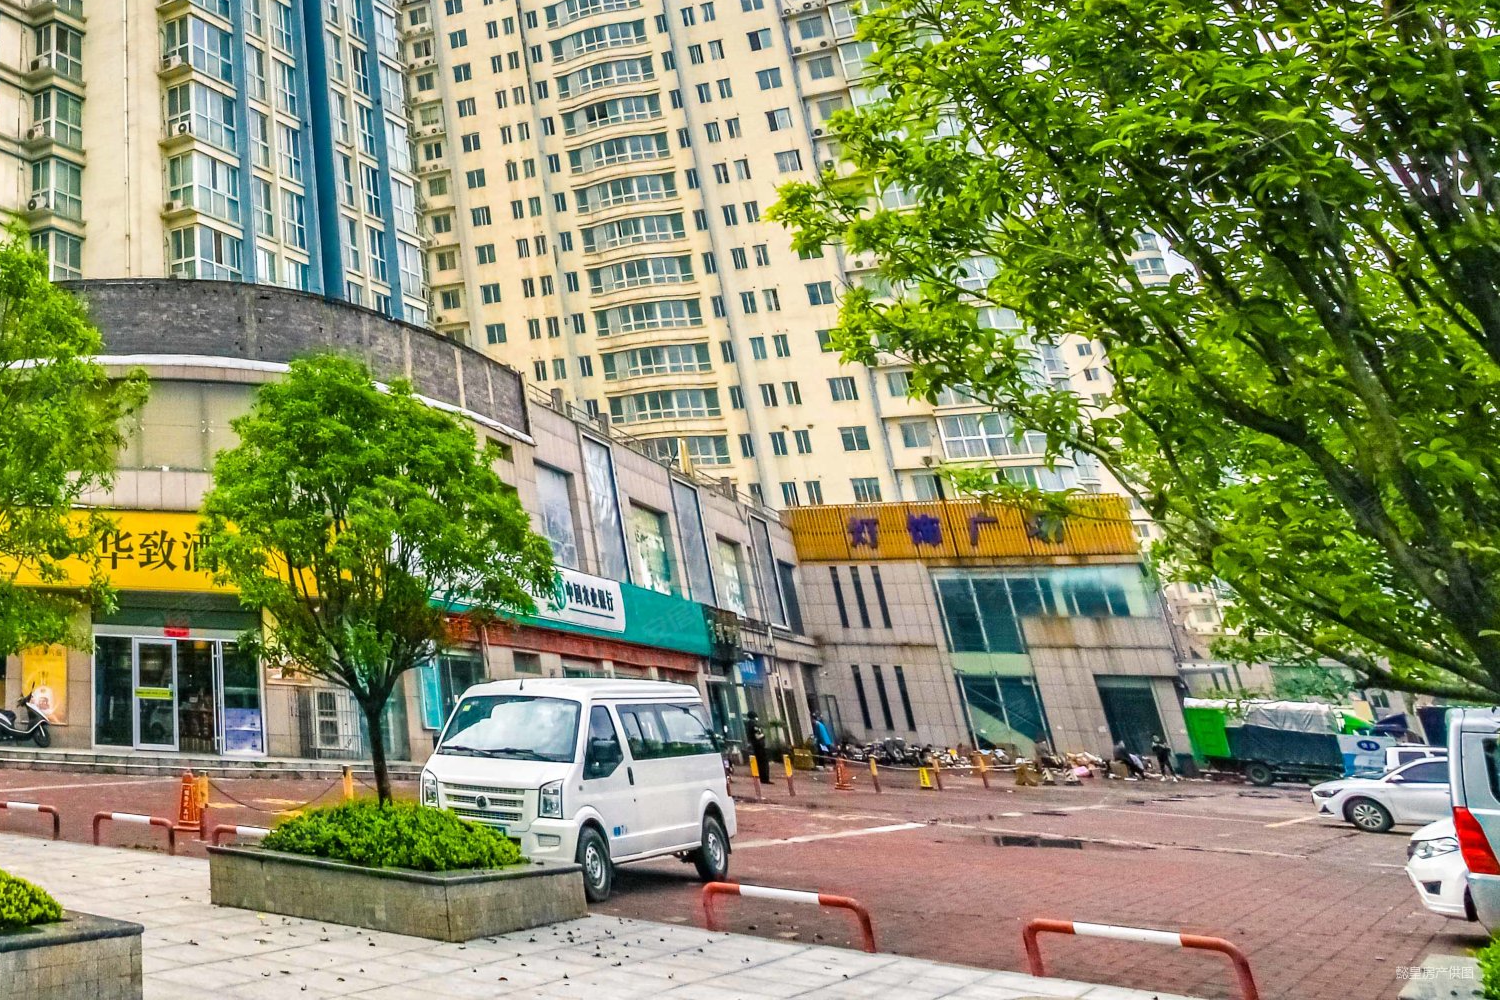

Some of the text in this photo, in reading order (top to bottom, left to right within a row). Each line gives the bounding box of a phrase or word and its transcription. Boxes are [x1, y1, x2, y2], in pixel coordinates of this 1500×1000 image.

[564, 580, 614, 612] 中国农业银行
